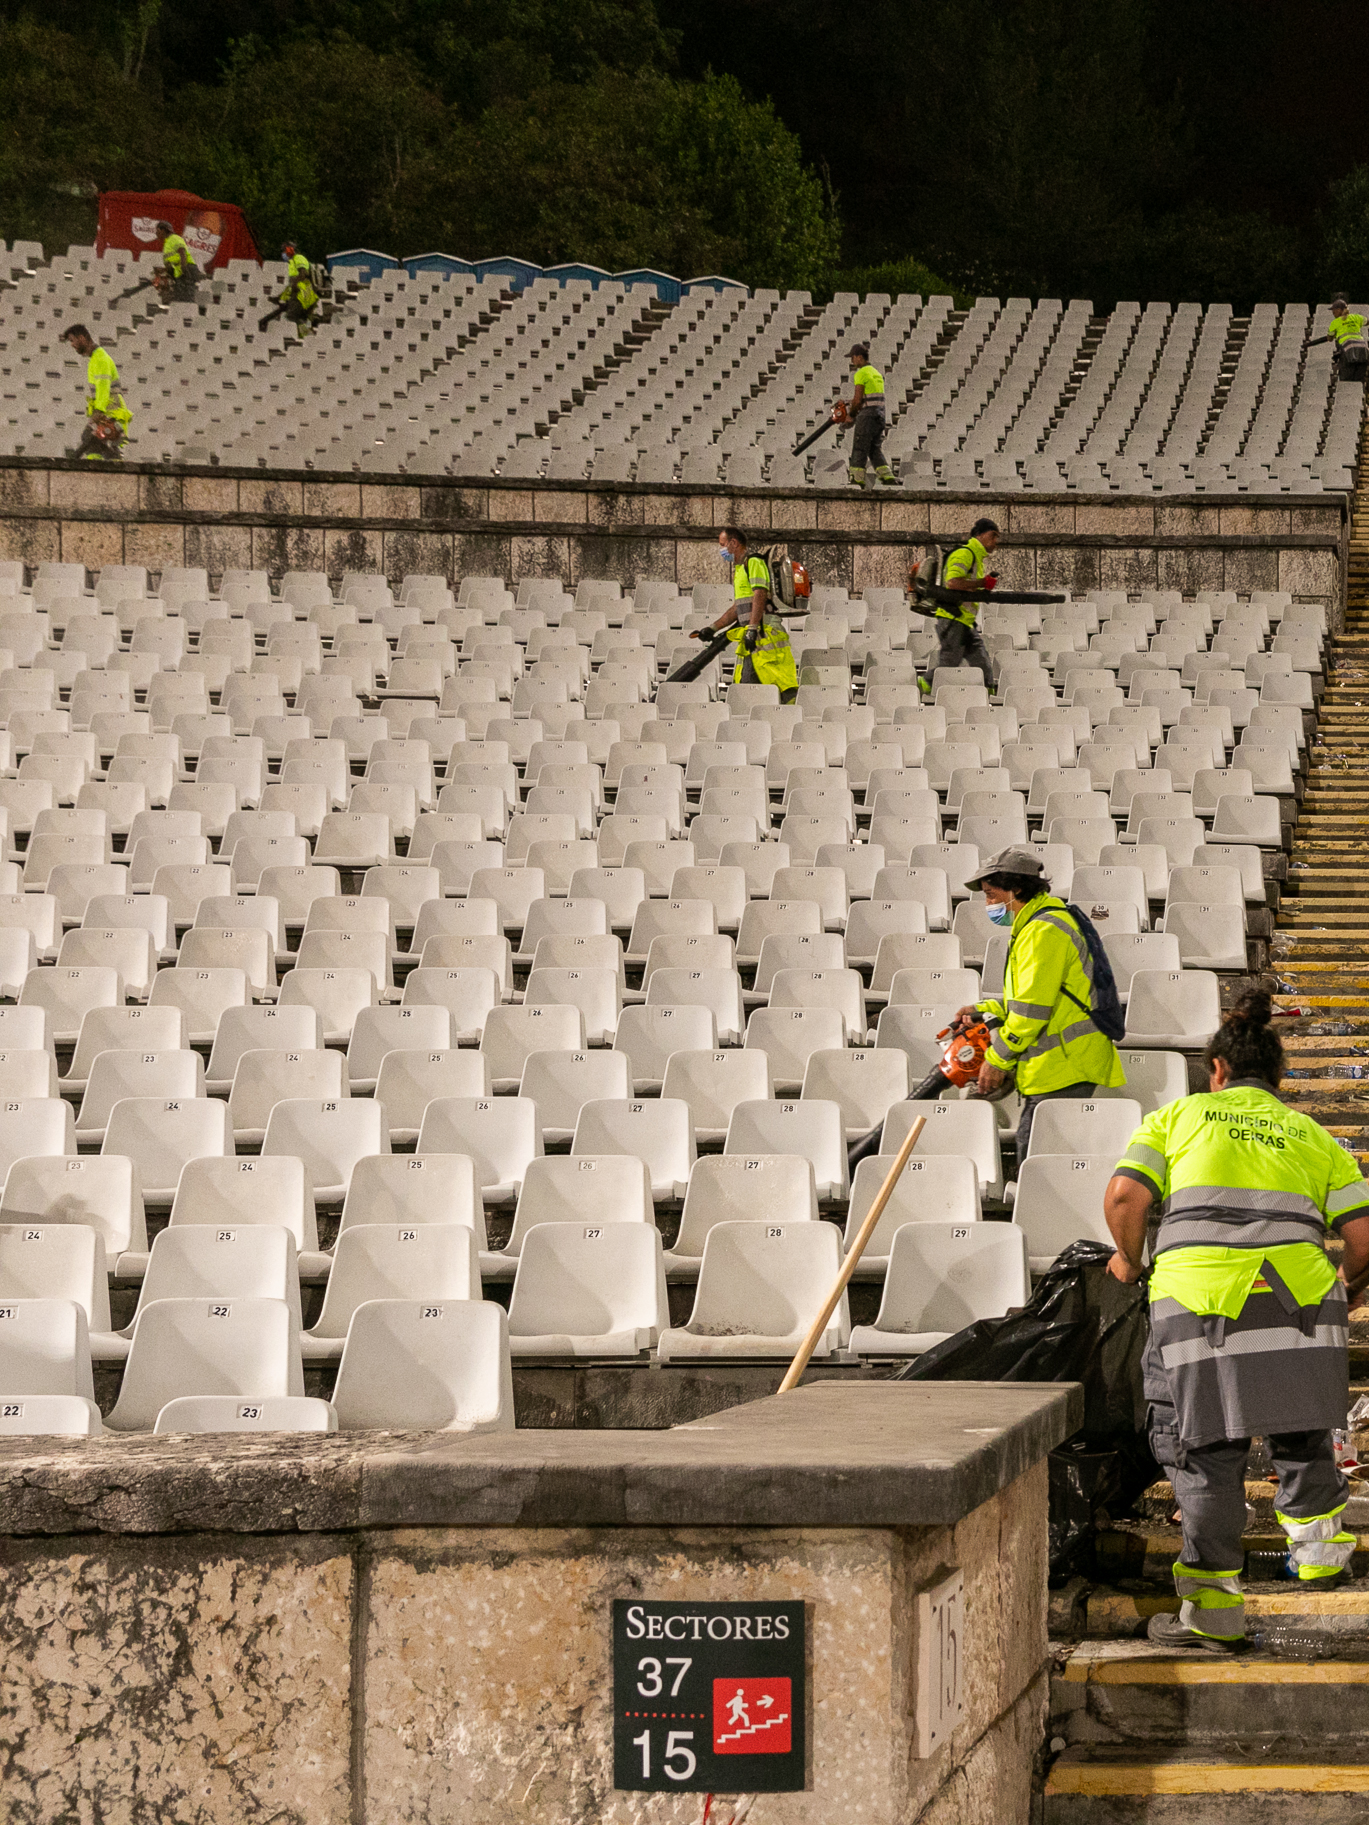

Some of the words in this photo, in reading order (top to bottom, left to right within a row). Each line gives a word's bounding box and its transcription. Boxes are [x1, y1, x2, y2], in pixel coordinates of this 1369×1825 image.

[716, 1054, 726, 1062] 27
[168, 1102, 180, 1110] 24
[326, 1103, 337, 1111] 25
[633, 1105, 644, 1113] 27
[784, 1105, 795, 1113] 28
[1229, 1128, 1285, 1149] OEIRAS
[1288, 1127, 1307, 1141] DE
[242, 1164, 254, 1172] 24
[411, 1161, 423, 1169] 25
[748, 1161, 760, 1169] 27
[912, 1163, 924, 1171] 28
[1075, 1162, 1087, 1170] 29
[27, 1231, 40, 1240] 24
[219, 1232, 232, 1241] 25
[402, 1232, 415, 1241] 26
[588, 1230, 600, 1238] 27
[770, 1228, 782, 1237] 28
[955, 1230, 967, 1238] 29
[213, 1307, 228, 1317] 22
[424, 1308, 438, 1318] 23
[4, 1406, 19, 1416] 22
[242, 1408, 258, 1418] 23
[626, 1606, 790, 1640] SECTORES
[637, 1657, 693, 1697] 37
[633, 1729, 697, 1780] 15
